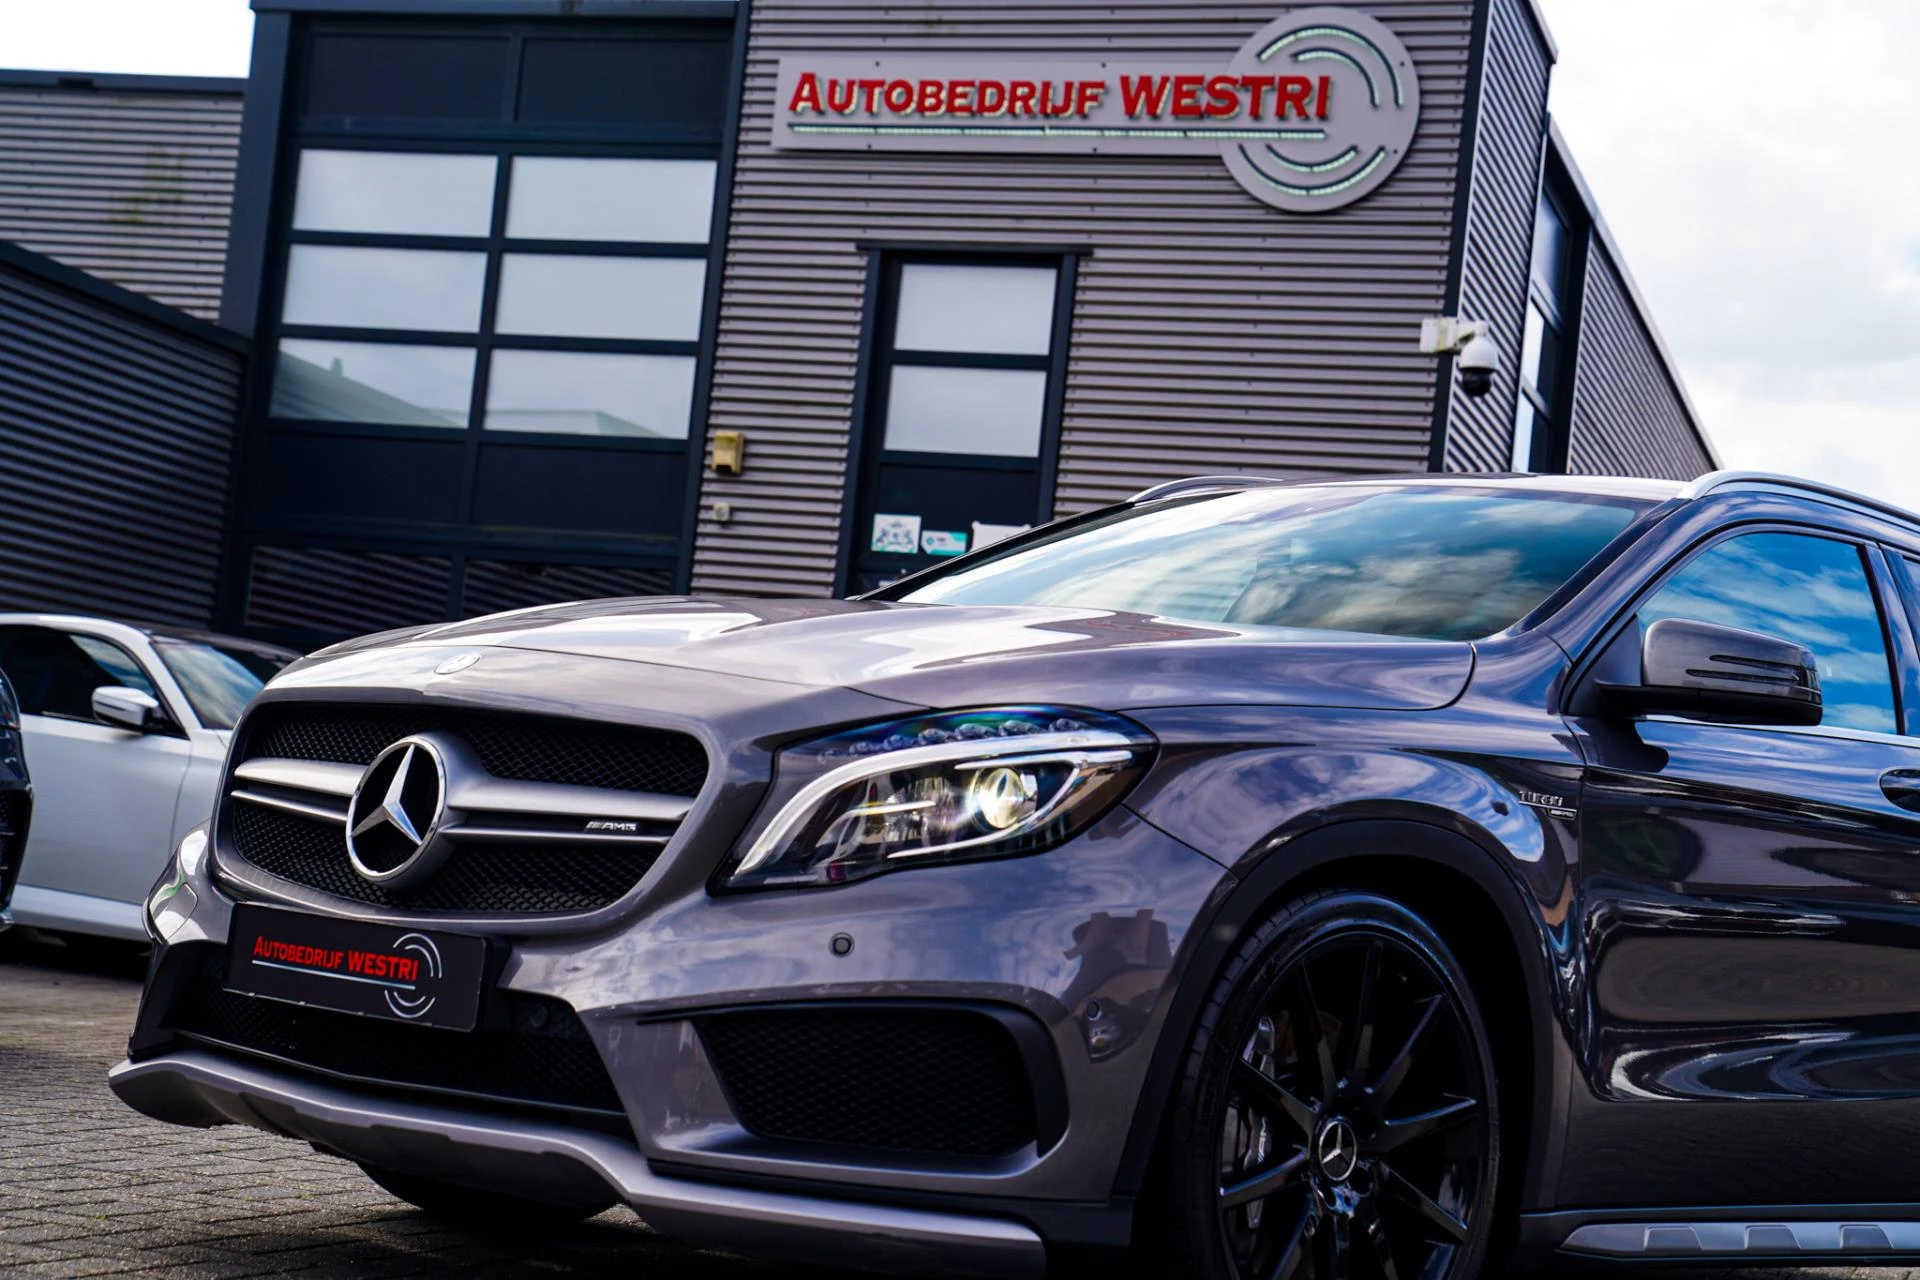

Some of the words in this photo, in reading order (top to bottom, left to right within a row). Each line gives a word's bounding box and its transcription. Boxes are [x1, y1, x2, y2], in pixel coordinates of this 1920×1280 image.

[789, 72, 1106, 116] AUTOBEDRIJF
[1119, 74, 1331, 119] WESTRI
[253, 935, 345, 970] AUTOBEDRIJF
[347, 949, 419, 981] WESTRI
